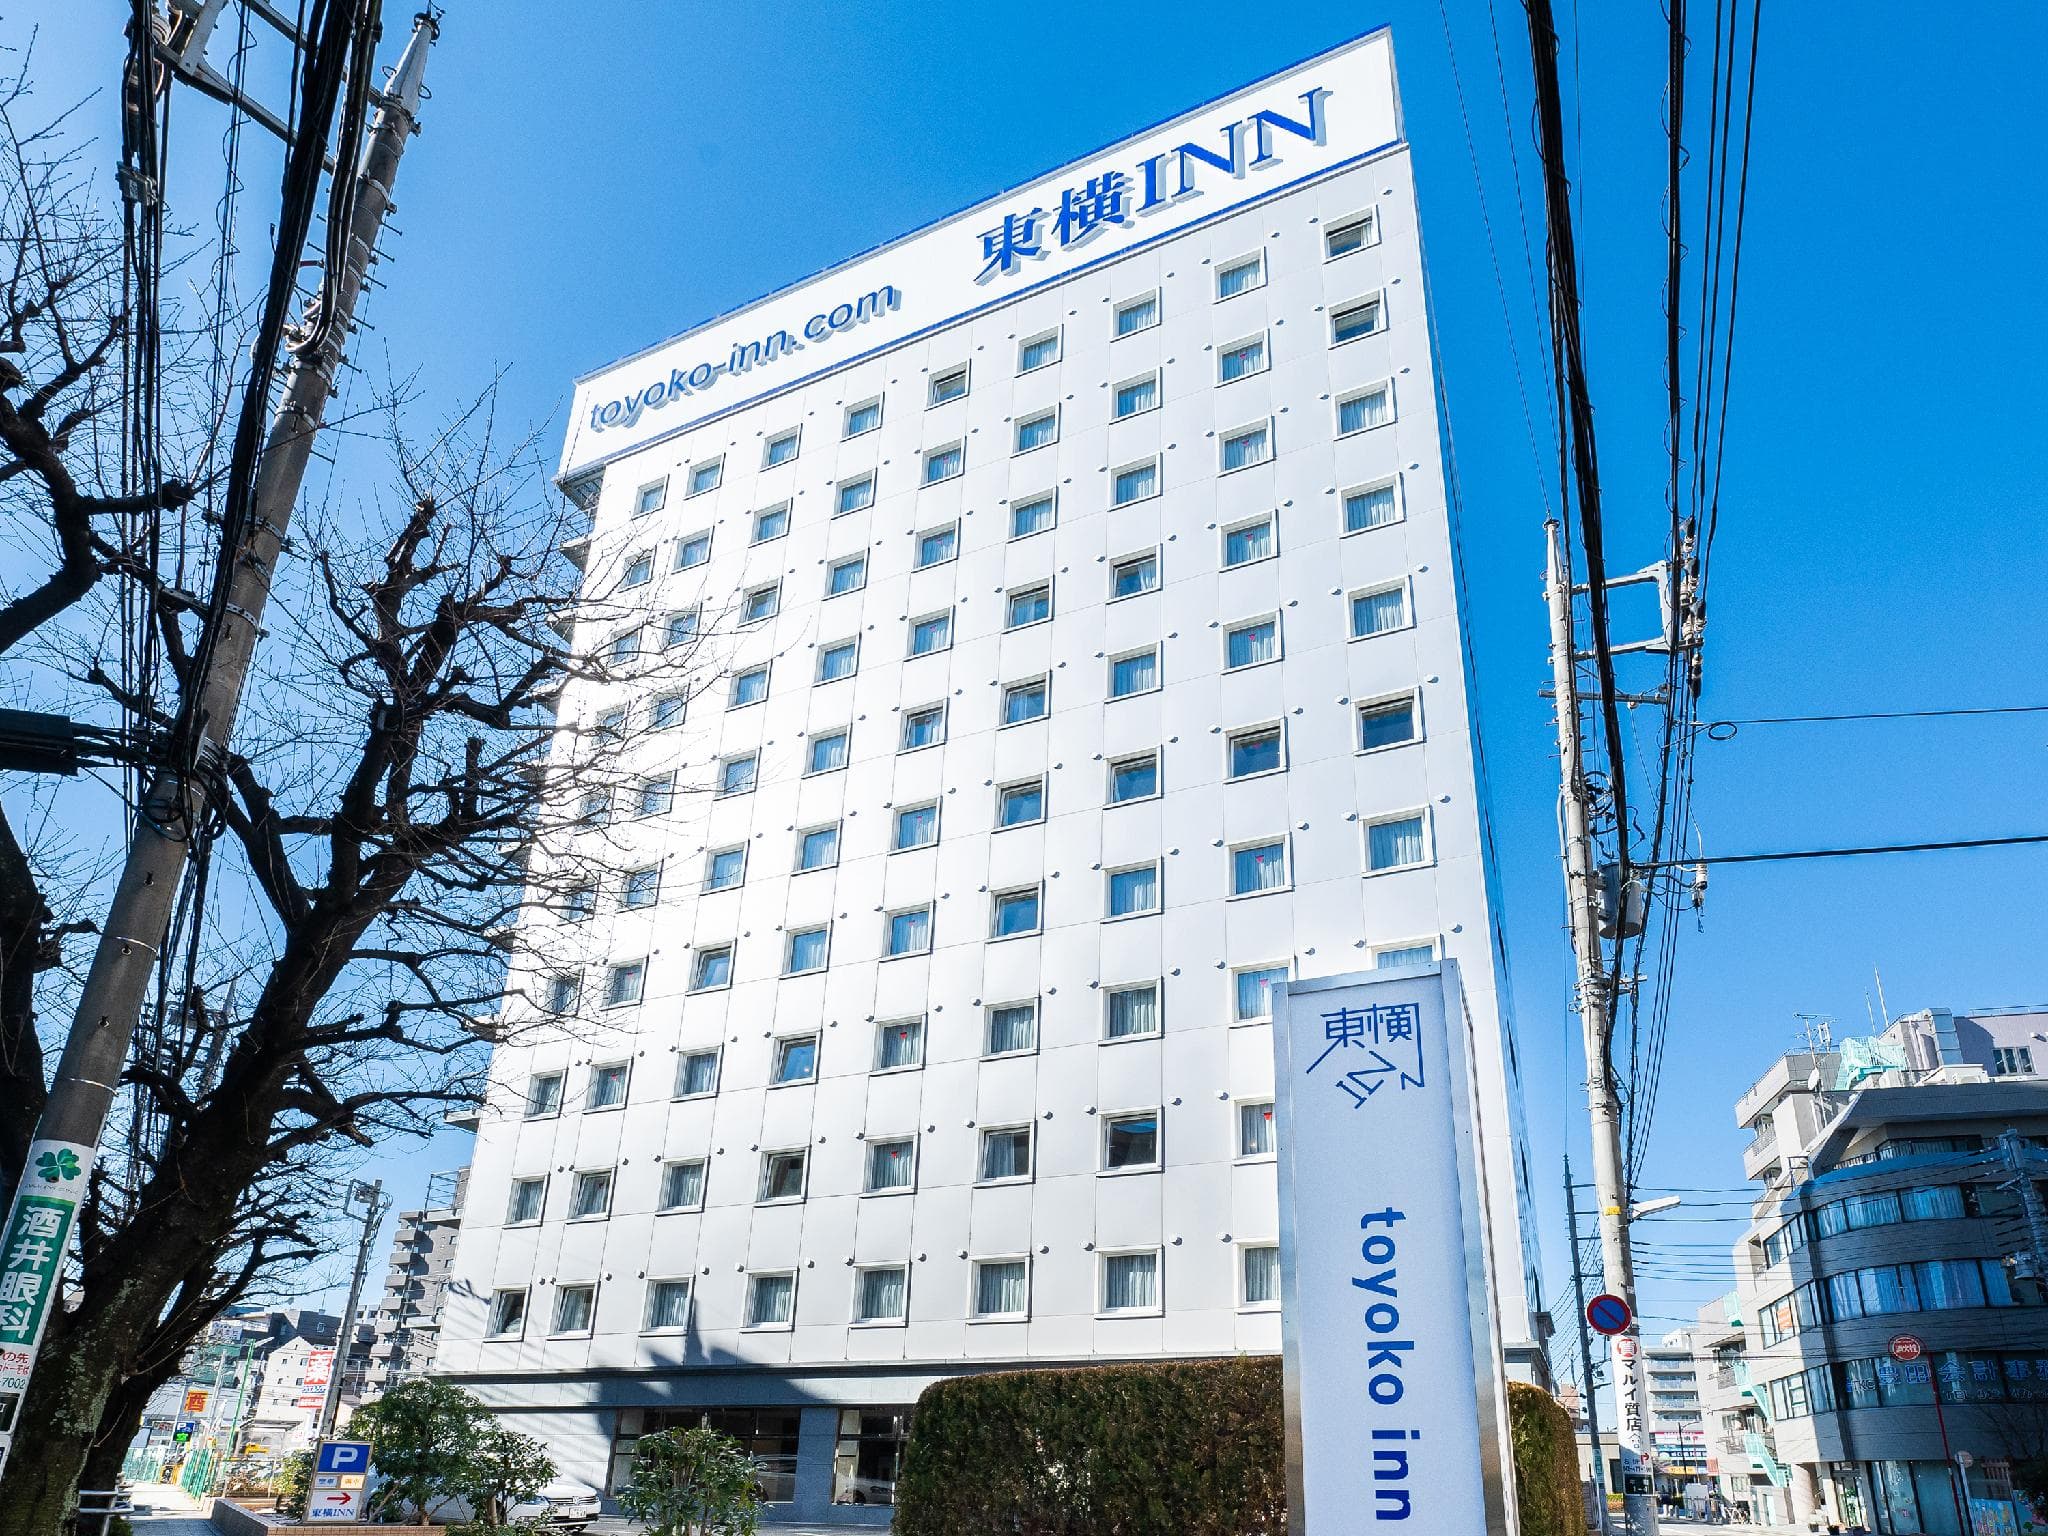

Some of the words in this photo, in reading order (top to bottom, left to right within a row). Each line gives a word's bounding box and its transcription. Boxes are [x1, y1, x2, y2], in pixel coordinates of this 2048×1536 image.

[974, 85, 1333, 285] 東横INN
[588, 280, 902, 434] toyoko-inn.com
[0, 1205, 66, 1339] 酒井眼科
[1352, 1207, 1414, 1406] toyoko
[1621, 1359, 1642, 1432] マルイ質店
[312, 1508, 355, 1517] 東横INN
[331, 1447, 358, 1468] P
[1372, 1429, 1420, 1521] inn
